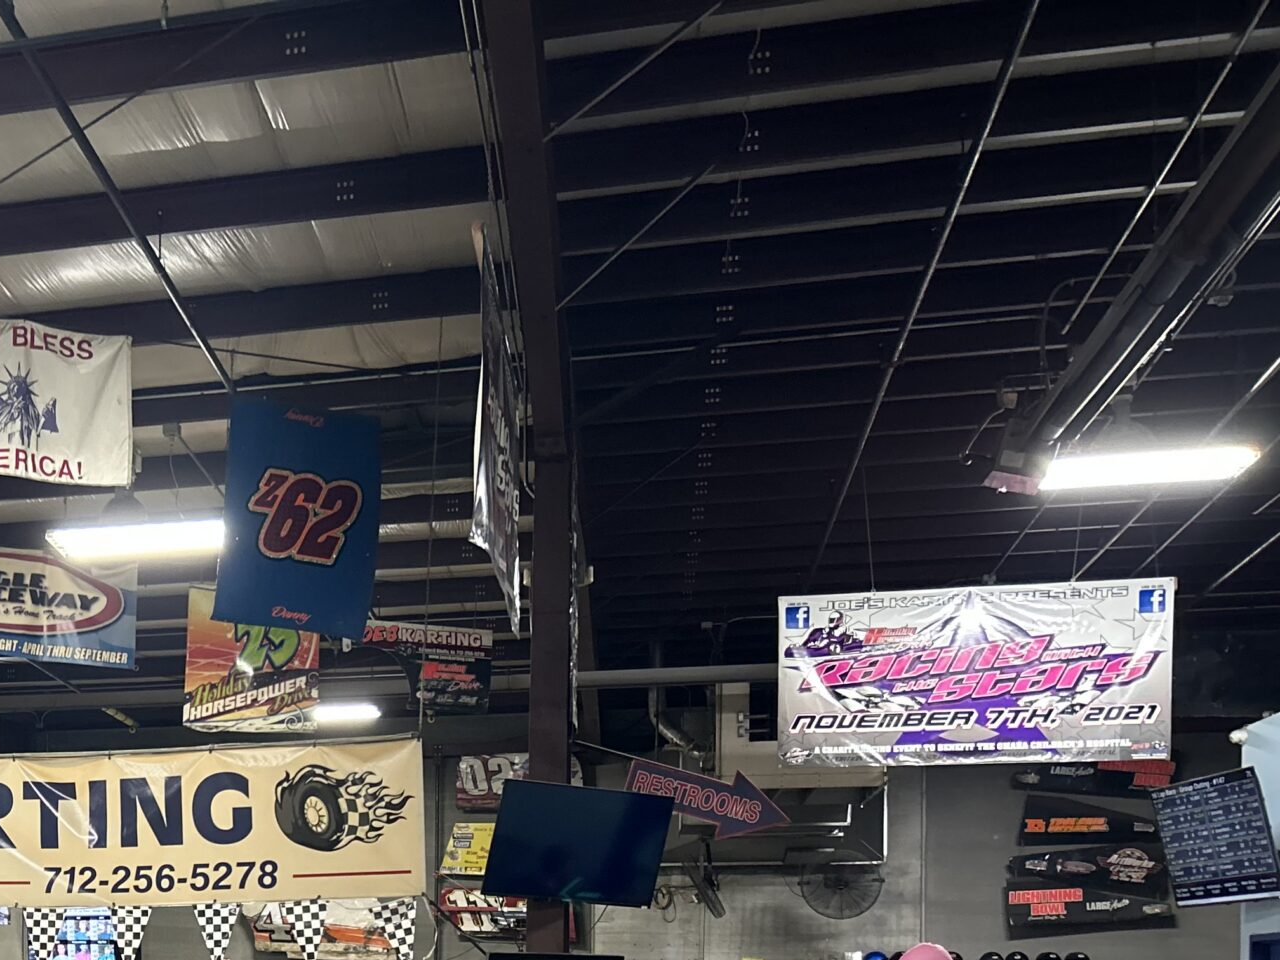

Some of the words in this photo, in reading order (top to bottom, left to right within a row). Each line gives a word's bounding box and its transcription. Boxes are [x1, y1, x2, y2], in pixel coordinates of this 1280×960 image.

[11, 324, 94, 360] BLESS
[819, 596, 884, 611] JOE'S
[999, 586, 1129, 600] PRESENTS
[12, 606, 39, 618] Home
[271, 606, 312, 624] Danny
[401, 627, 481, 647] KARTING
[22, 642, 44, 656] APRIL
[46, 643, 71, 658] THRU
[73, 646, 128, 664] SEPTEMBER
[190, 675, 307, 720] HORSEPOWER
[788, 708, 977, 734] NOVEMBER
[1081, 705, 1160, 726] 2021
[1086, 738, 1132, 748] HOSPITAL
[632, 770, 762, 825] RESTROOMS
[43, 859, 278, 896] 712-256-5278
[1009, 888, 1083, 904] LIGHTNING
[1031, 903, 1067, 915] BOWL
